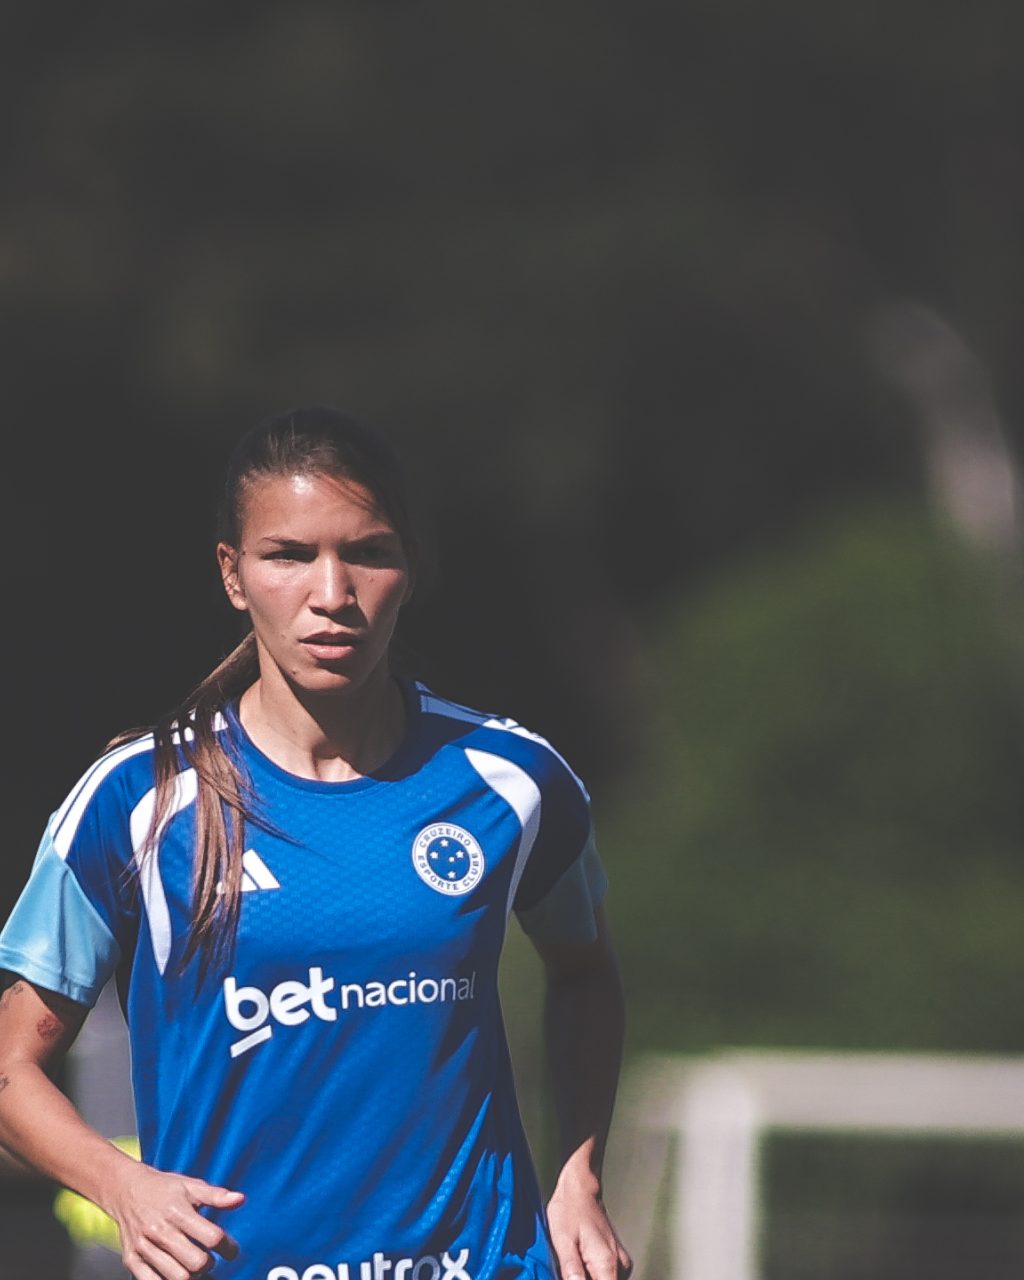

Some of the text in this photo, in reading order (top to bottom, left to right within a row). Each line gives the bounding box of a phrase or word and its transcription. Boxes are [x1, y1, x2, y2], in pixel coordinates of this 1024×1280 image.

[419, 827, 472, 848] CRUZEIRO
[417, 852, 480, 891] ESPORTE CLUBE
[223, 967, 476, 1058] bet nacional
